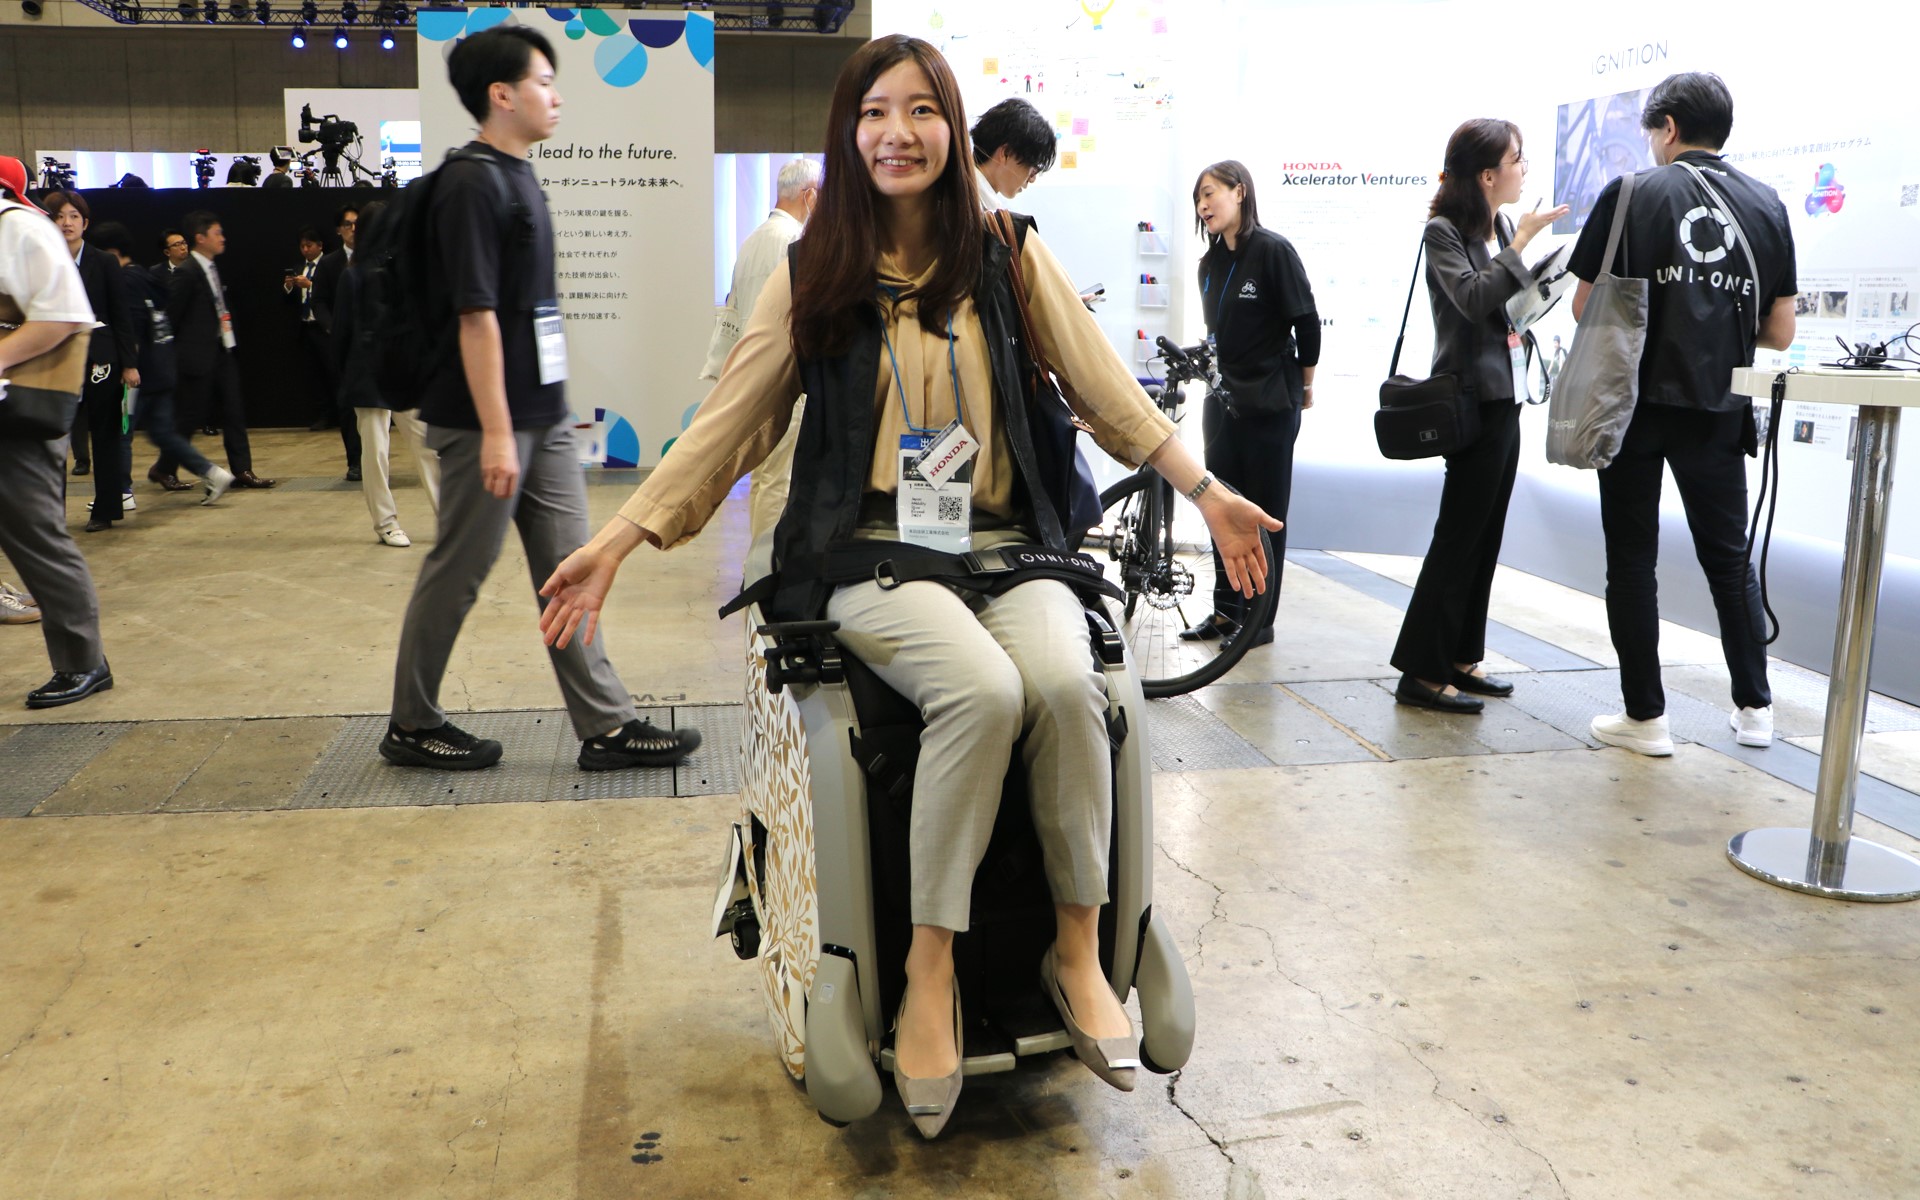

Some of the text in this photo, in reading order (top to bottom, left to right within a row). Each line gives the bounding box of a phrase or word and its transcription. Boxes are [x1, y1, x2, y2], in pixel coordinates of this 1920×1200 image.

[1591, 39, 1669, 76] IGNITION
[538, 143, 573, 159] lead
[578, 146, 593, 159] to
[598, 143, 623, 159] the
[627, 143, 677, 160] future.
[1282, 162, 1342, 170] HONDA
[1281, 172, 1428, 186] Xcelerator Ventures
[1656, 265, 1754, 296] UNI-ONE
[929, 439, 968, 478] HONDA
[1035, 553, 1097, 571] UNI-ONE
